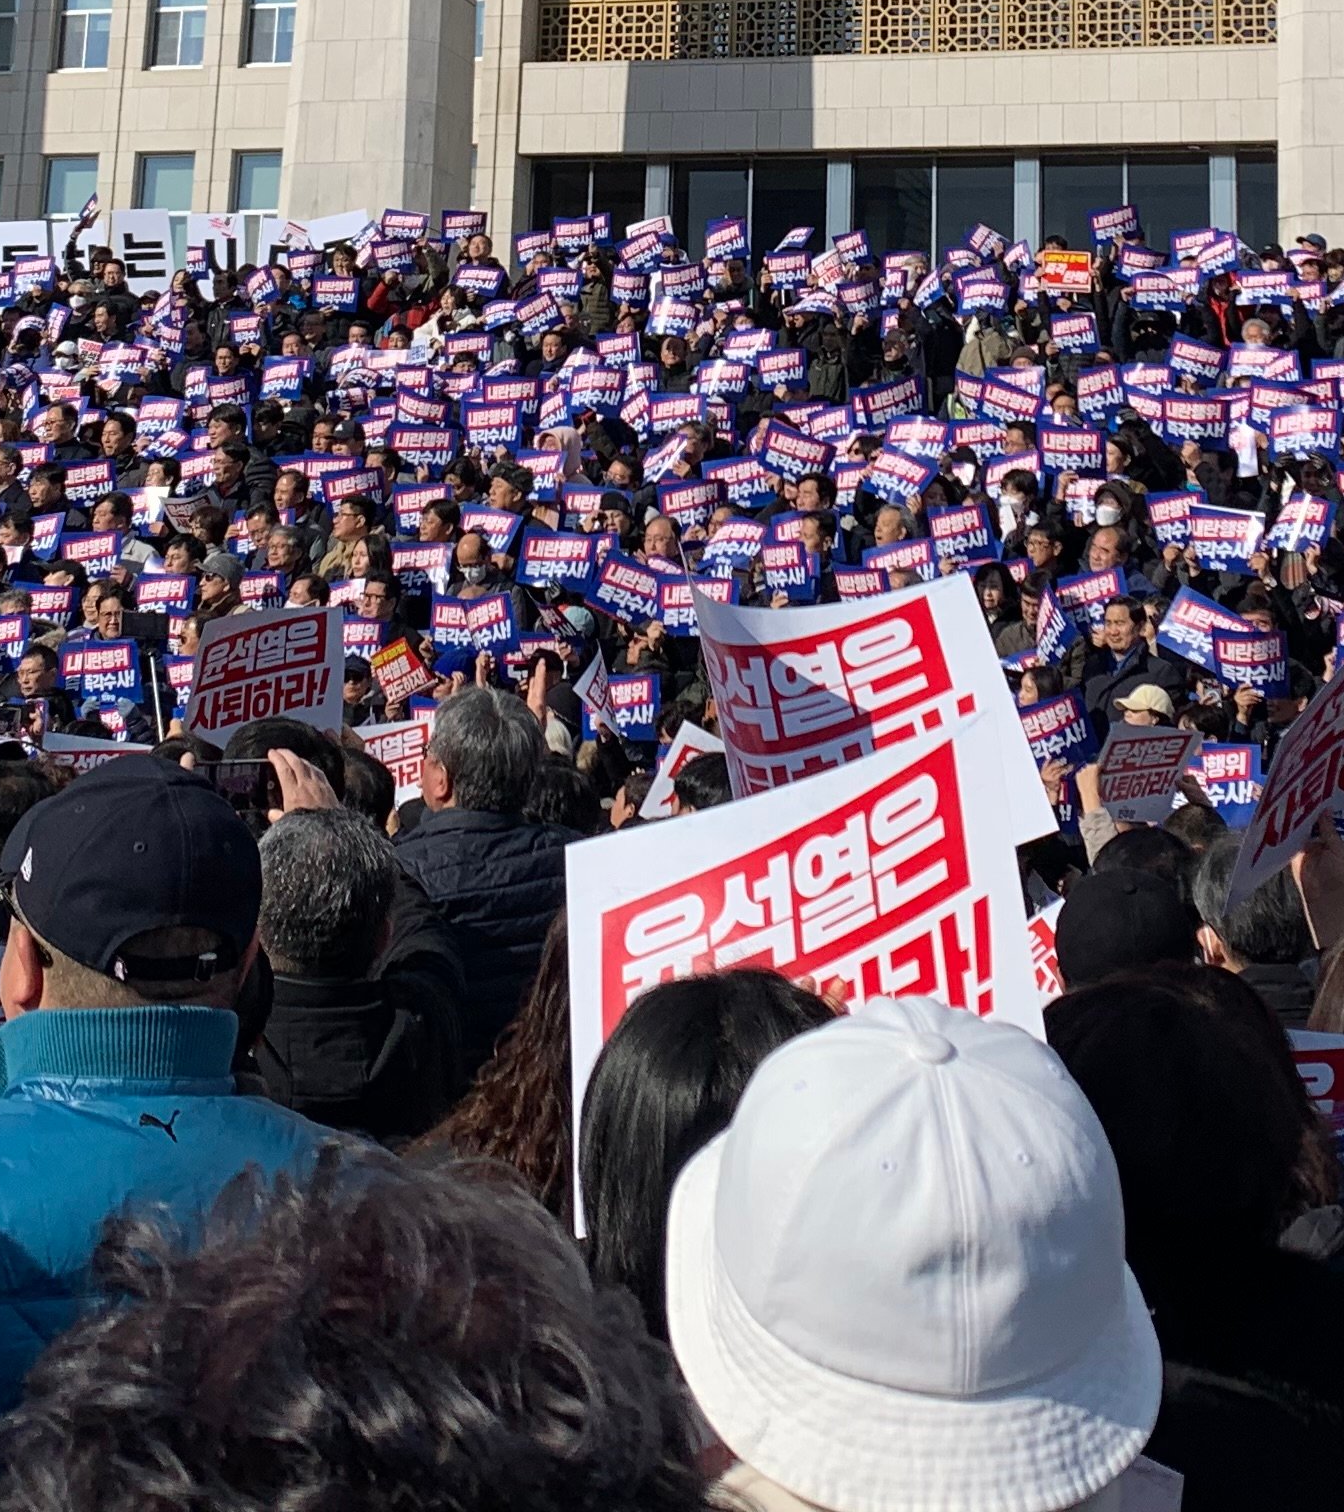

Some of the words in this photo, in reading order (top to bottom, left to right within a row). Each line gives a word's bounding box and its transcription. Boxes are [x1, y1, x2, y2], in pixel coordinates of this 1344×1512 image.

[527, 539, 588, 559] 내란행위
[201, 613, 320, 681] 윤석열은
[1219, 637, 1281, 662] 내란행위
[191, 668, 332, 731] 사퇴하라!
[1108, 740, 1185, 770] 윤석열은
